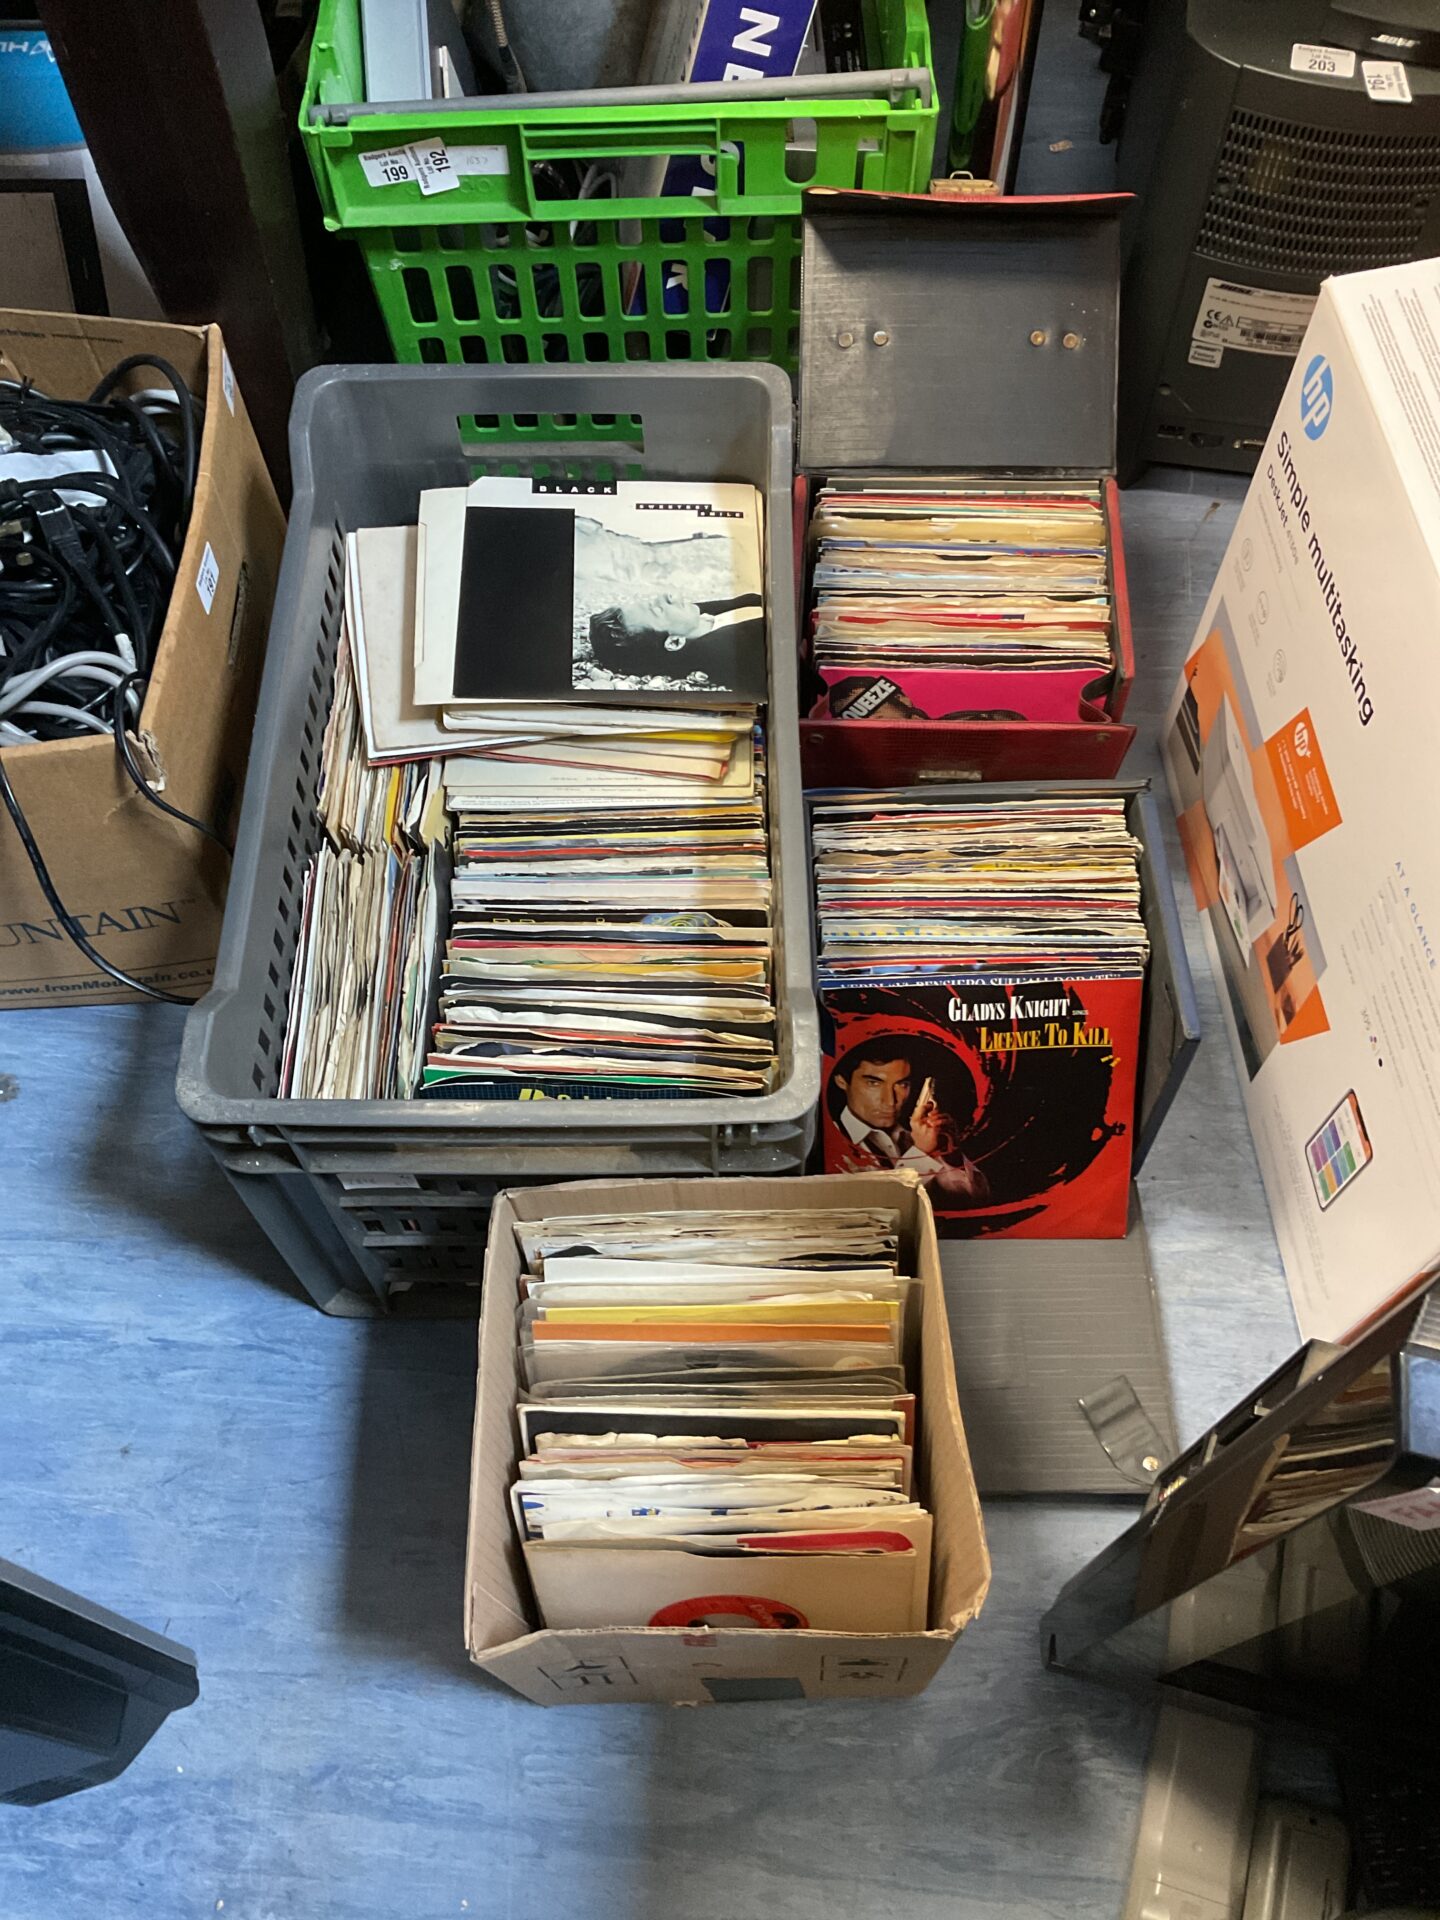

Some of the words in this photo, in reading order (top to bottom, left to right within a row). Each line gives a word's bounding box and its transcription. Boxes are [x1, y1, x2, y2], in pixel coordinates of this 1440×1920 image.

[1309, 59, 1336, 73] 203
[1367, 74, 1386, 91] 194
[382, 165, 409, 182] 199
[429, 149, 451, 173] 192
[1301, 354, 1333, 441] hp
[539, 485, 612, 494] BLACK
[1267, 463, 1288, 529] DeskJet
[1277, 431, 1310, 533] Simple
[1308, 531, 1374, 727] multitasking
[838, 679, 897, 719] QUEEZE
[1410, 902, 1437, 970] GLANCE
